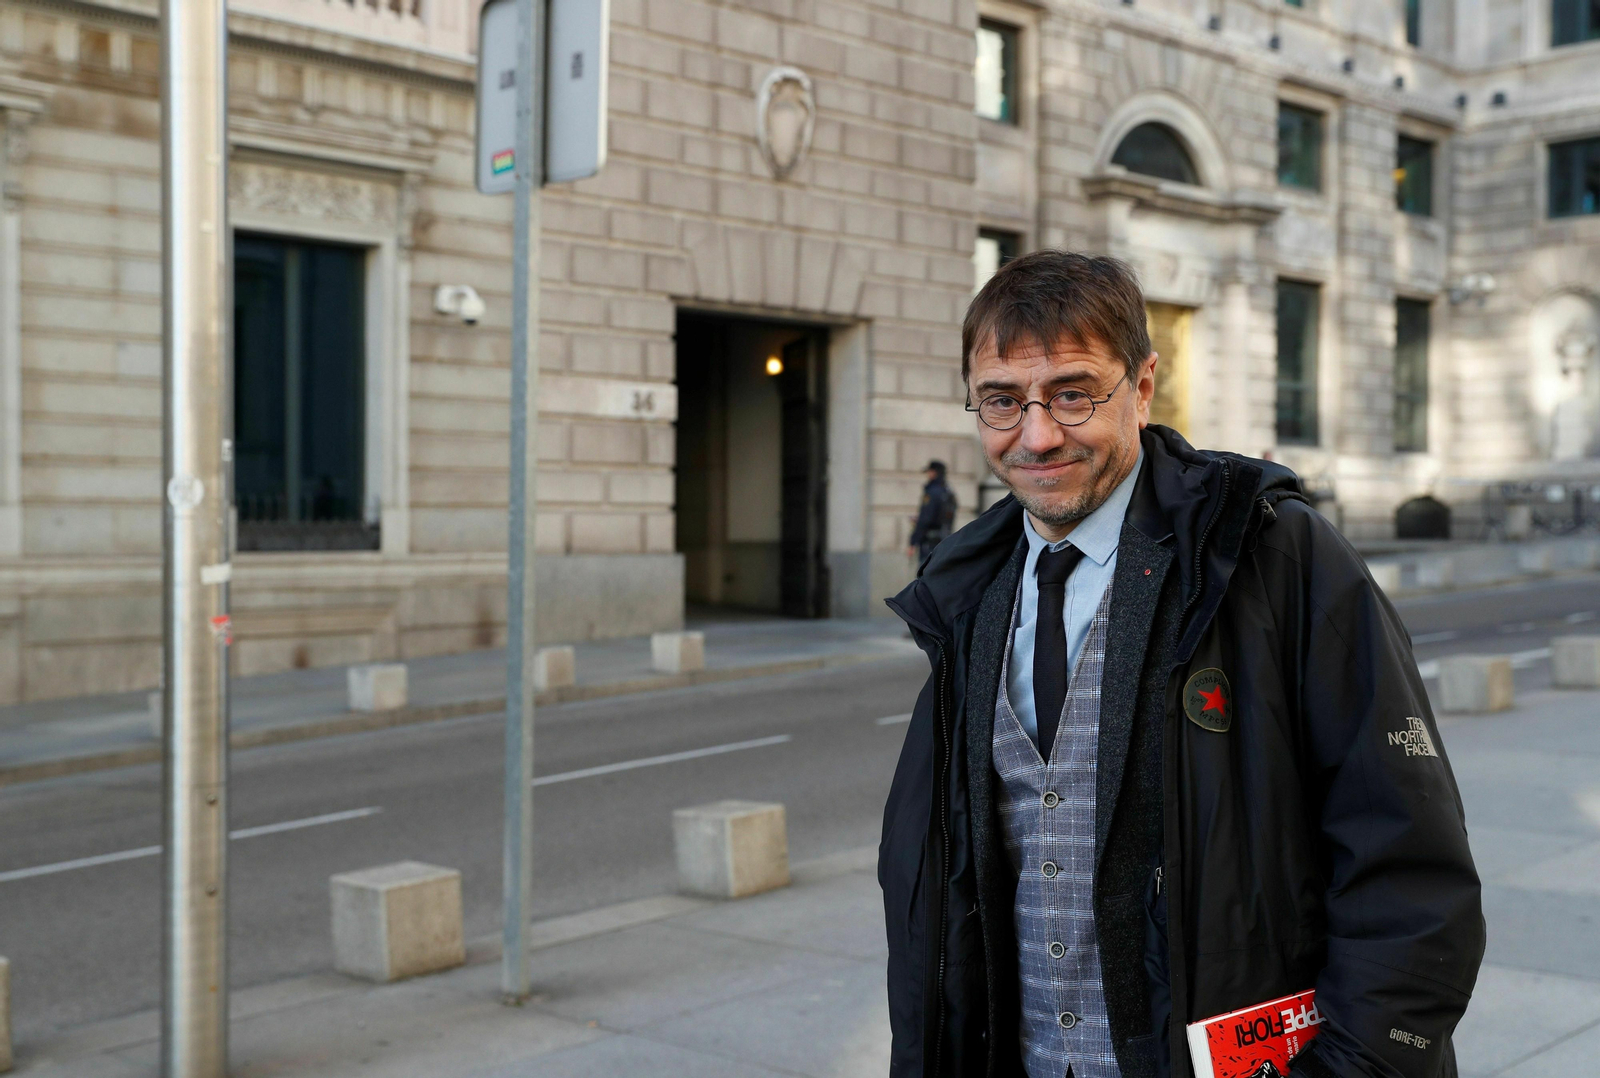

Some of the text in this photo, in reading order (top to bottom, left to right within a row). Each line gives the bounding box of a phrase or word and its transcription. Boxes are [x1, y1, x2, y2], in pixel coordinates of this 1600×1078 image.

[1406, 716, 1423, 731] THE
[1387, 730, 1425, 746] NORTH
[1404, 743, 1430, 757] FACE
